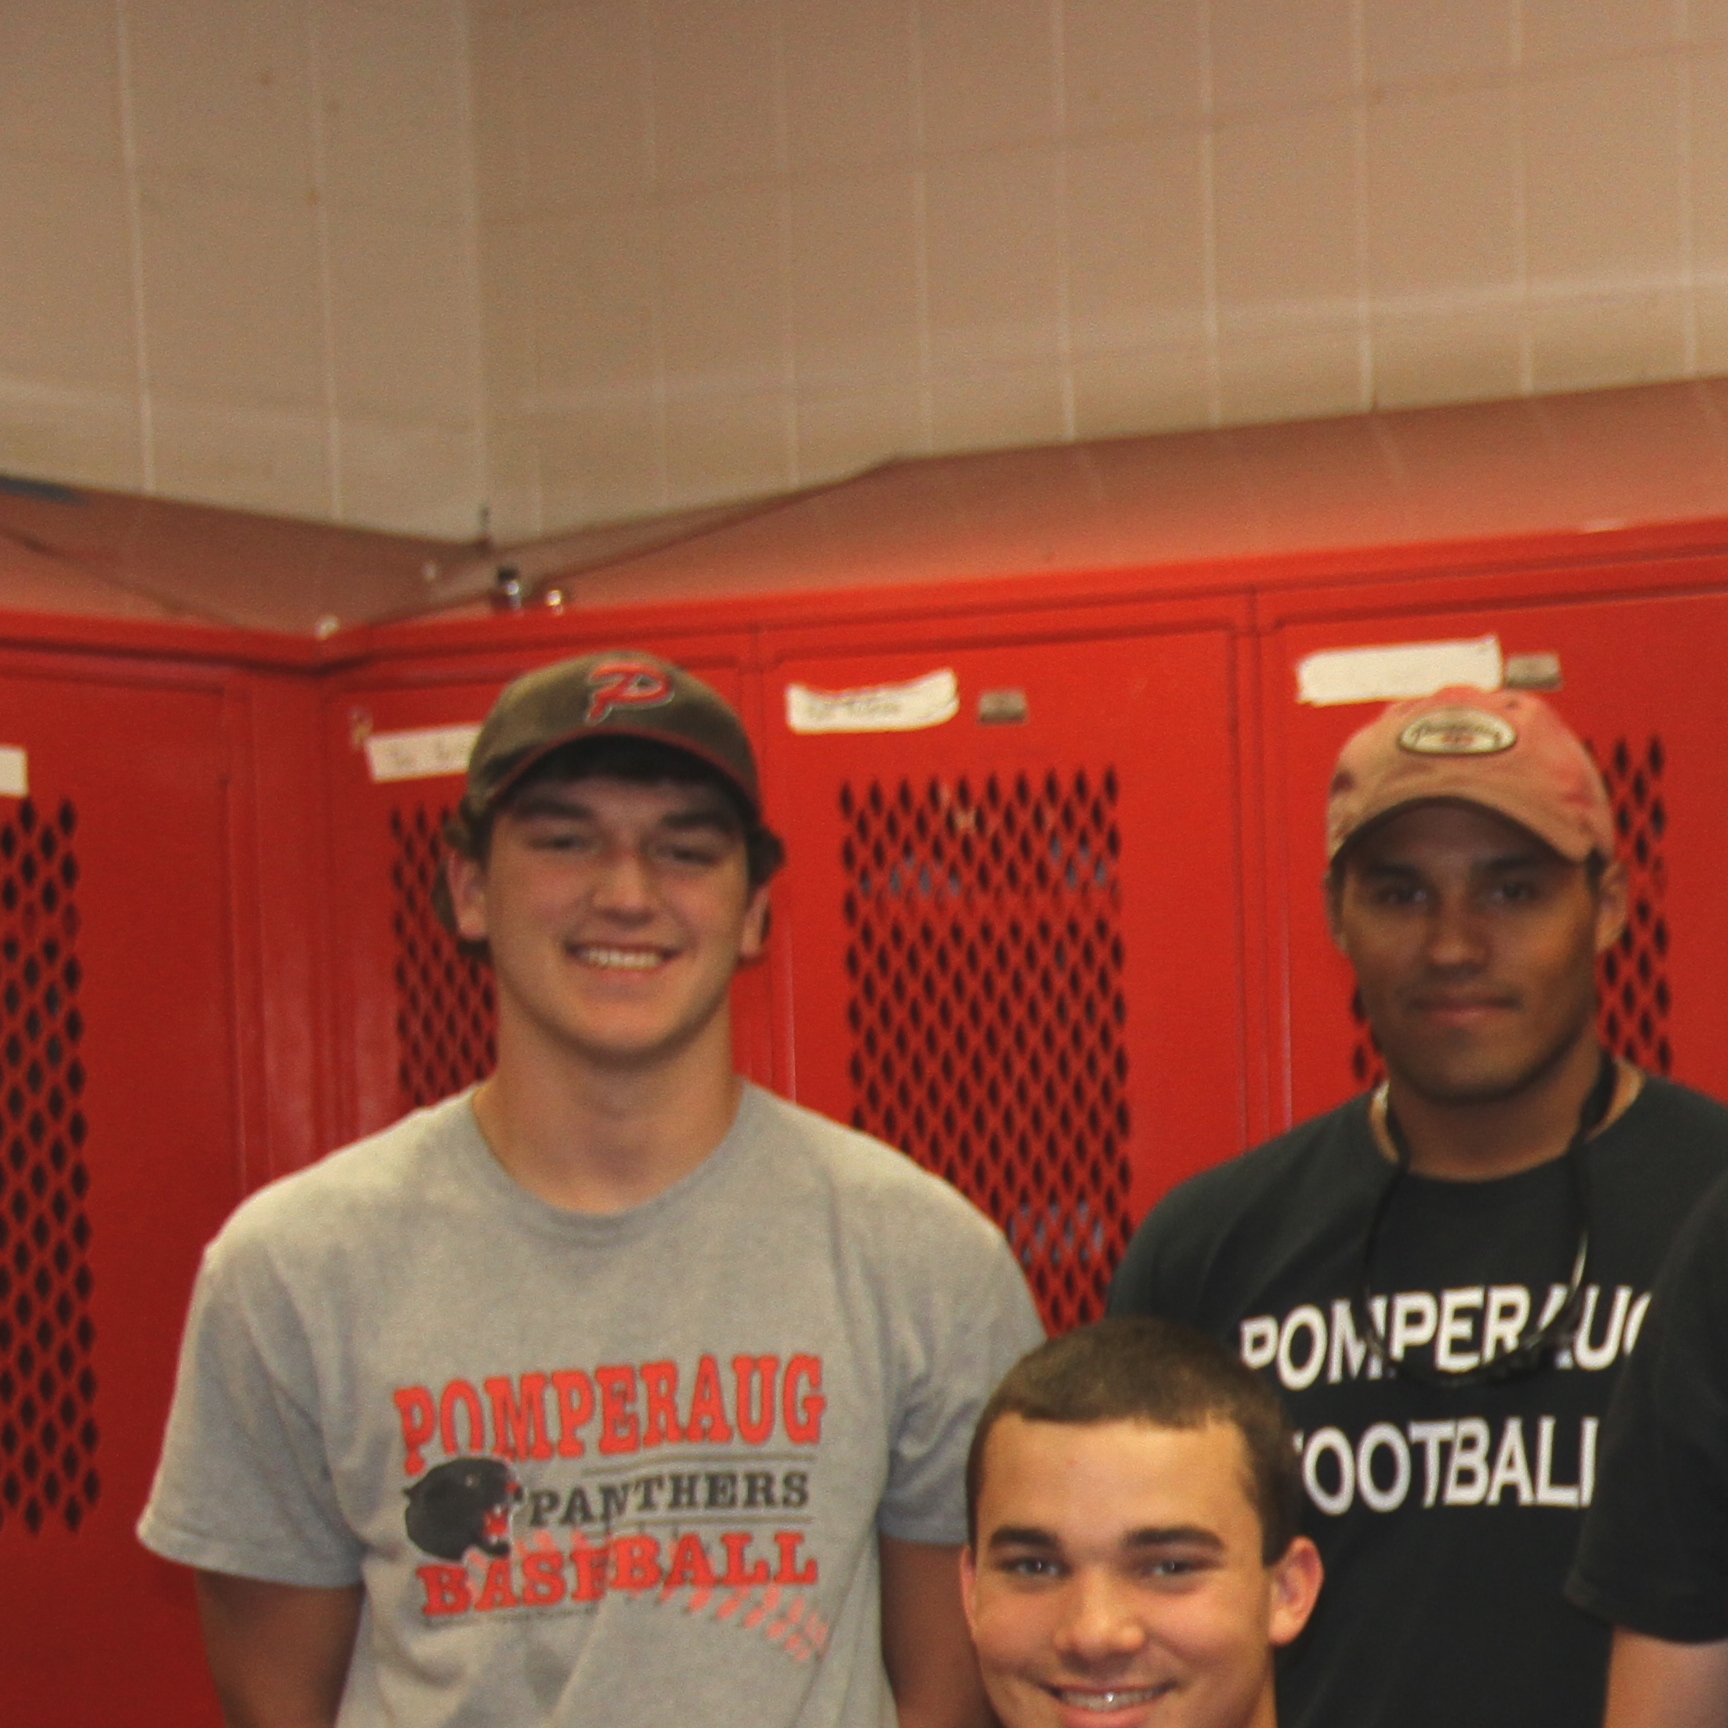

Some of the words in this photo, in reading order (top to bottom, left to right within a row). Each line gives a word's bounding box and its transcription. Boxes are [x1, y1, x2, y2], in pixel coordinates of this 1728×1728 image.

[583, 660, 675, 724] P
[393, 1353, 828, 1478] POMPERAUG
[528, 1470, 812, 1527] PANTHERS
[1292, 1416, 1599, 1517] OOTBALL
[416, 1532, 818, 1617] BASEBALL
